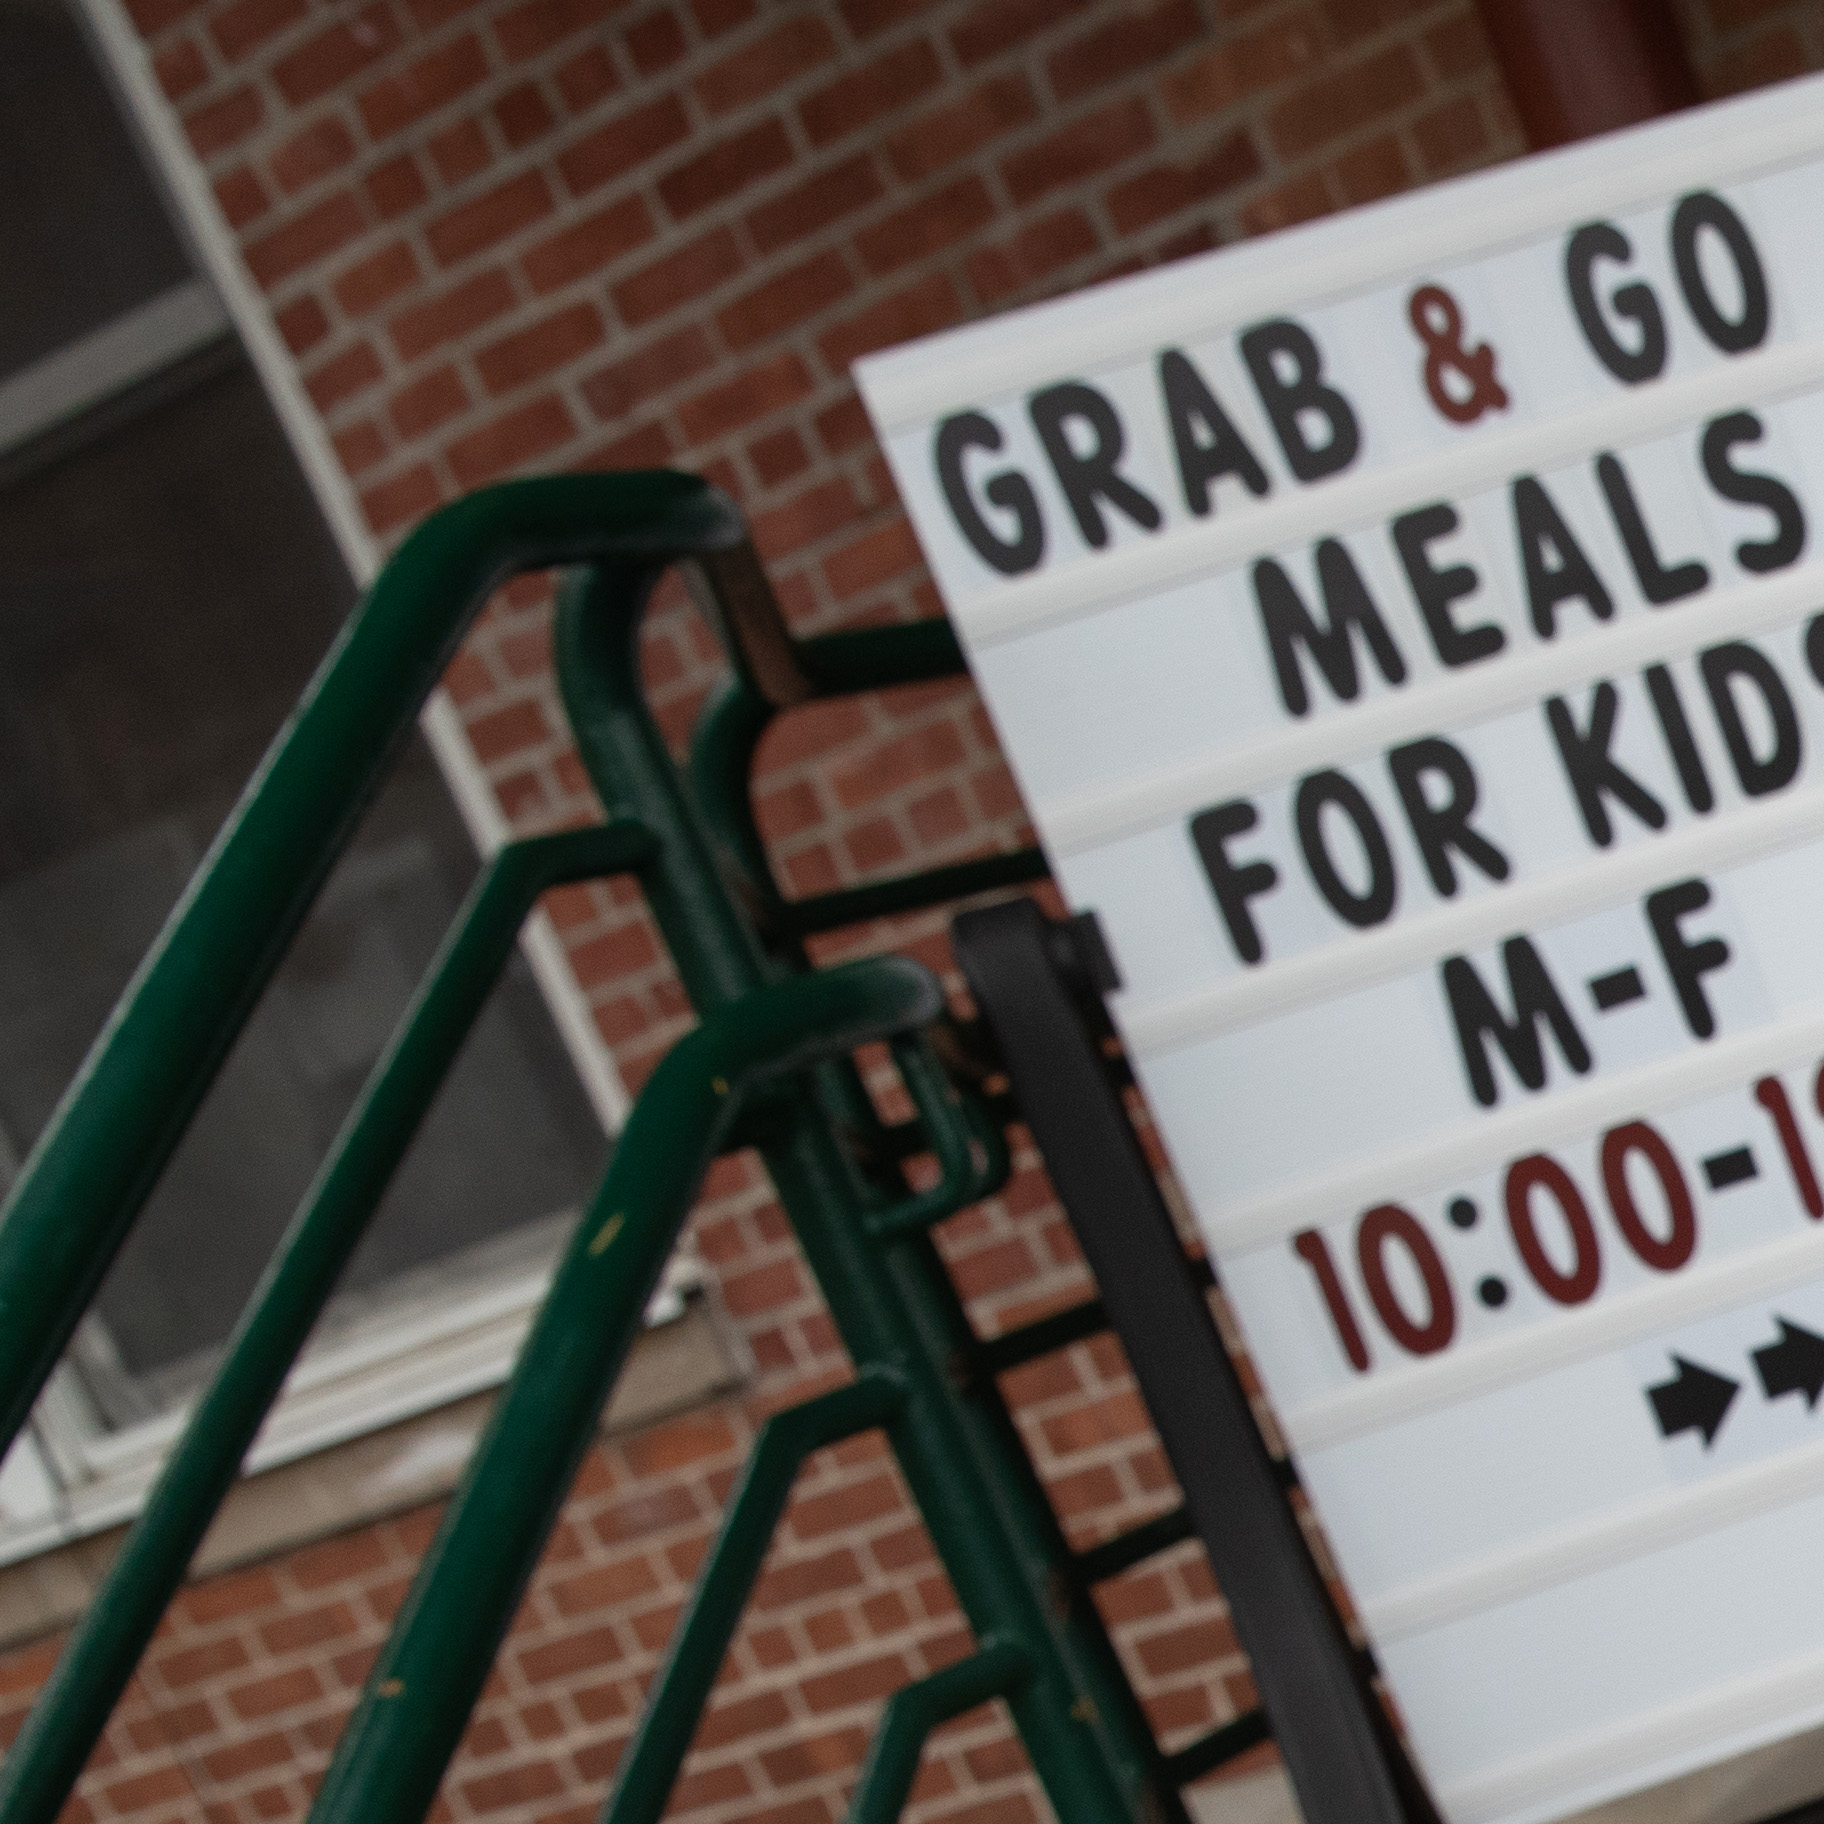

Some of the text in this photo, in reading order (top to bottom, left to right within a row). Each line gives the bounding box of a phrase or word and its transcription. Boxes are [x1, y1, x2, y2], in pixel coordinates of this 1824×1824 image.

[933, 190, 1772, 578] GRAB & GO
[1251, 410, 1808, 719] MEALS
[1188, 736, 1511, 967] FOR
[1441, 878, 1731, 1109] M-F
